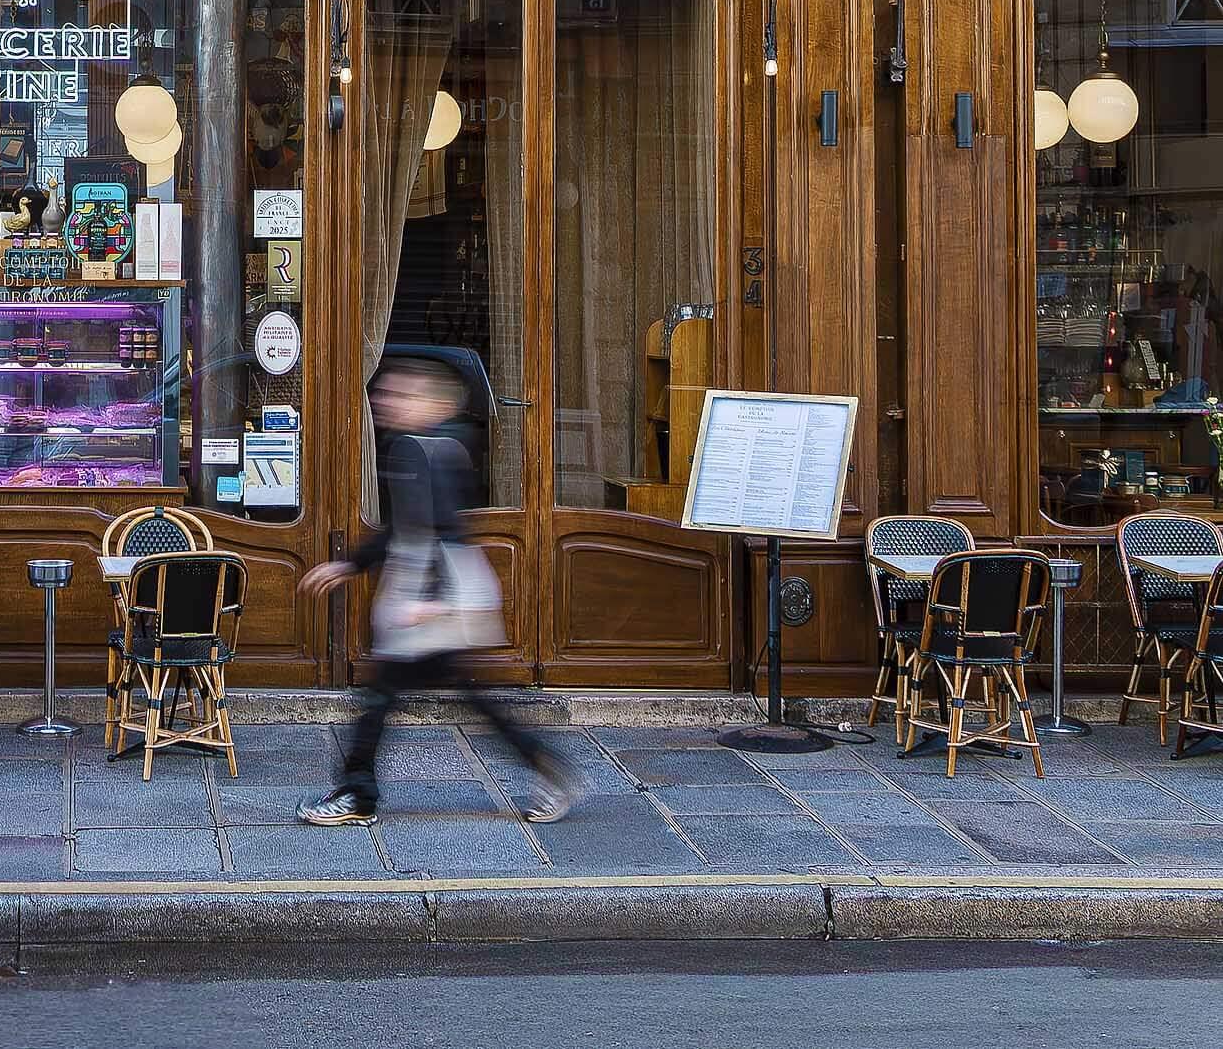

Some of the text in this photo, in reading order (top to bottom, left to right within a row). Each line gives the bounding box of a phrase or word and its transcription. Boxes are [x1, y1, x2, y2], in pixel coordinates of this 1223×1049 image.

[269, 226, 289, 234] 2025
[3, 273, 53, 287] DE LA
